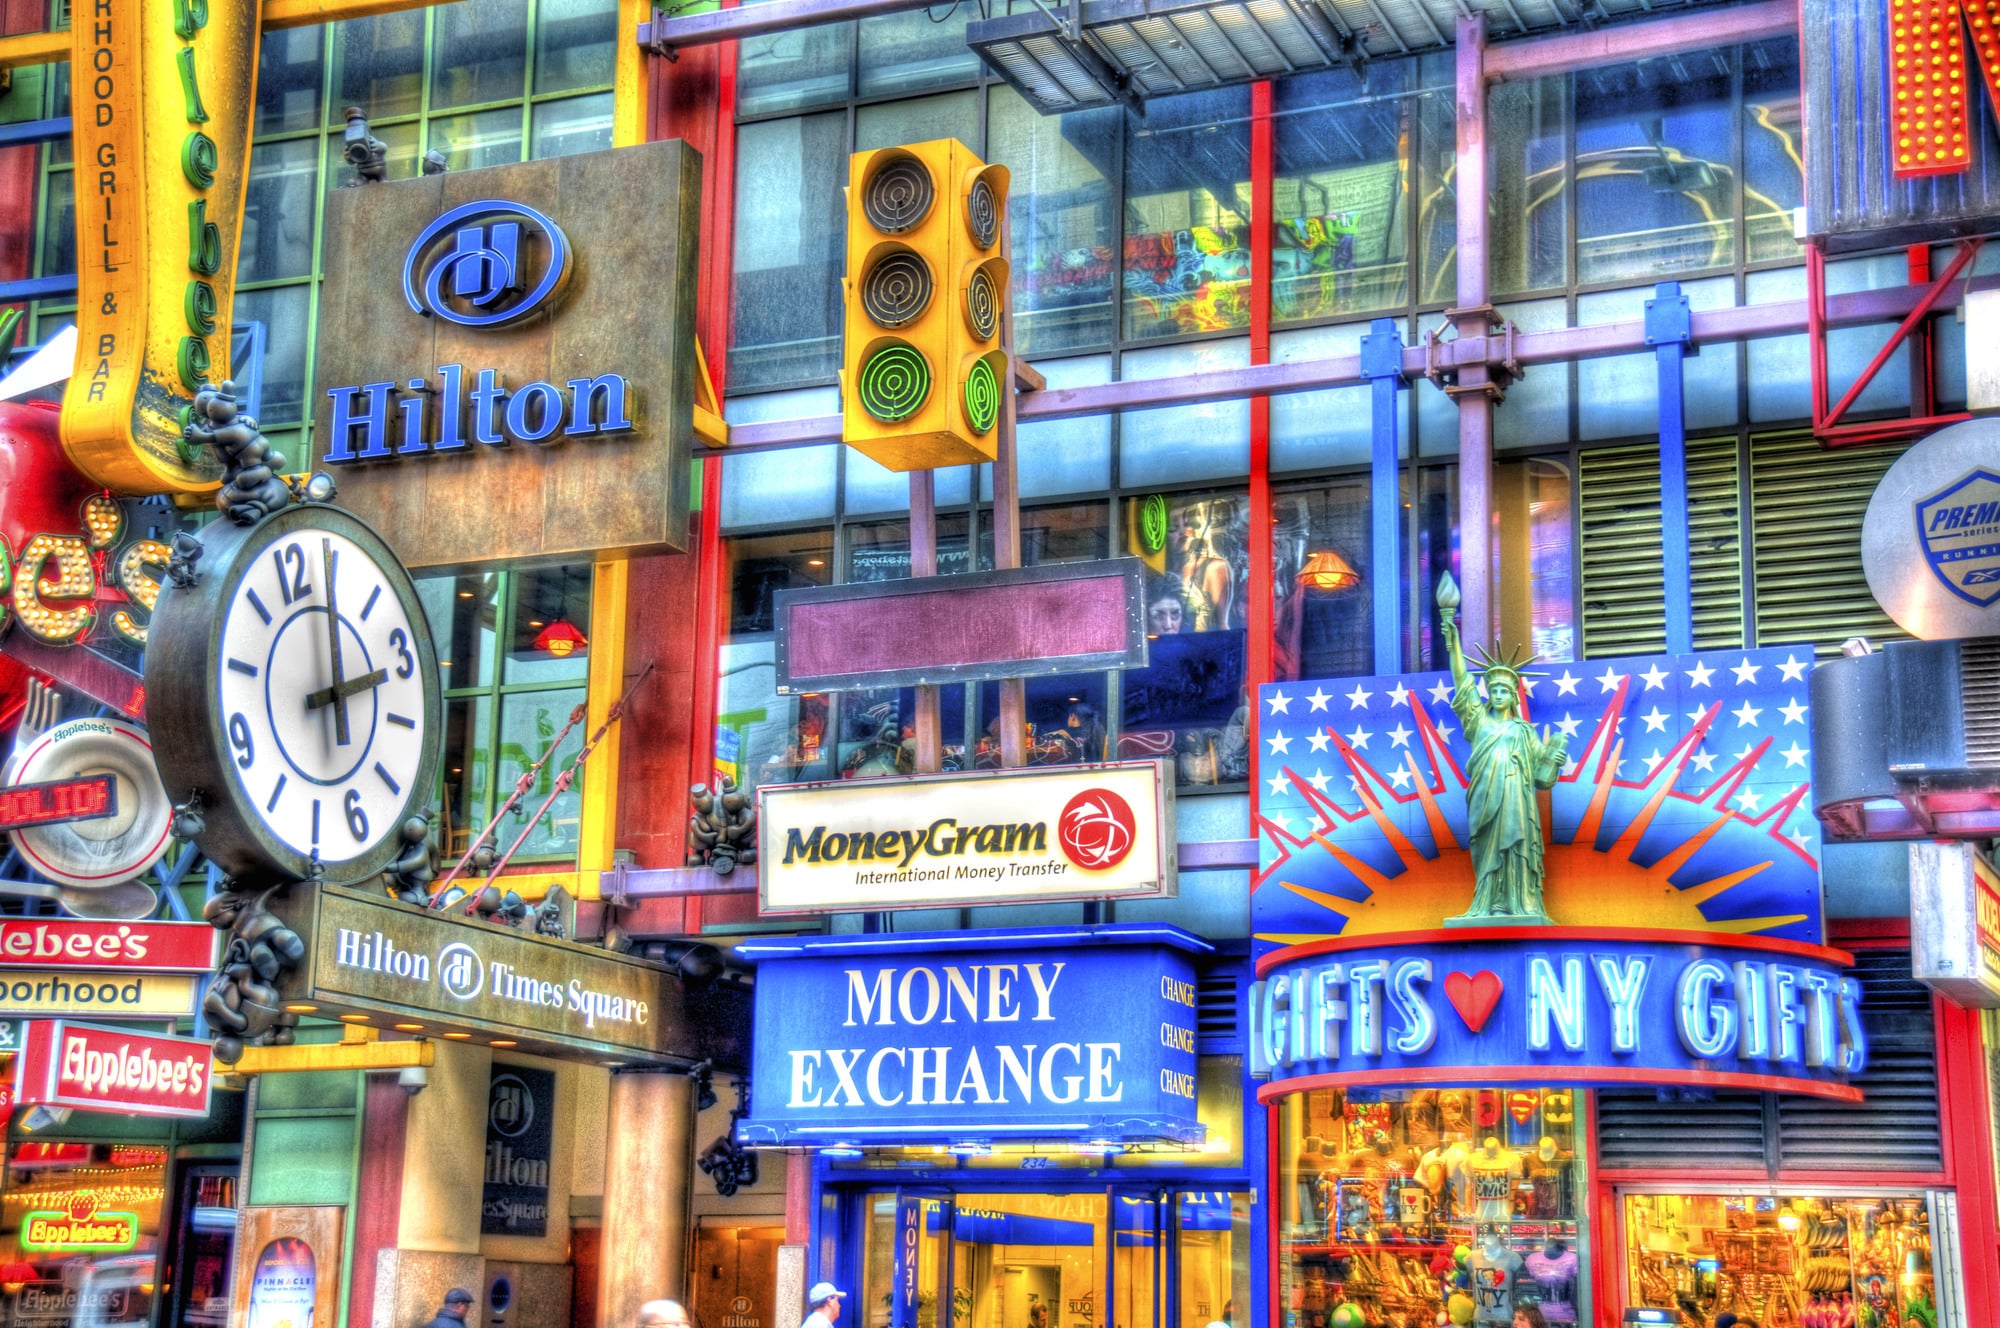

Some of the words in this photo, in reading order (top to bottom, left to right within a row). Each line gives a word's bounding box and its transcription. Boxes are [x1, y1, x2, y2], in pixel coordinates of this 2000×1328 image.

[96, 142, 119, 273] GRILL
[101, 291, 117, 315] &
[88, 333, 116, 402] BAR
[323, 362, 633, 464] Hilton
[1963, 526, 1999, 538] series
[274, 541, 313, 606] 12
[389, 628, 414, 679] 3
[54, 721, 112, 743] Applebee's
[228, 712, 255, 770] 9
[344, 788, 369, 842] 6
[782, 818, 1048, 868] MoneyGram
[855, 865, 951, 886] International
[955, 865, 1006, 882] Money
[1009, 859, 1069, 876] Transfer
[336, 928, 430, 981] Hilton
[490, 961, 564, 1008] Times
[568, 978, 649, 1028] Square
[842, 962, 1067, 1027] MONEY
[1160, 975, 1195, 1008] CHANGE
[1160, 1021, 1195, 1054] CHANGE
[1262, 956, 1438, 1068] GIFTS
[1524, 951, 1656, 1053] NY
[1674, 958, 1865, 1074] GIFTS
[62, 1036, 206, 1095] Applebee's
[785, 1041, 1124, 1109] EXCHANGE
[1160, 1067, 1194, 1099] CHANGE
[1021, 1158, 1048, 1169] 234
[30, 1220, 132, 1243] Applebee's
[722, 1314, 760, 1328] Hilton
